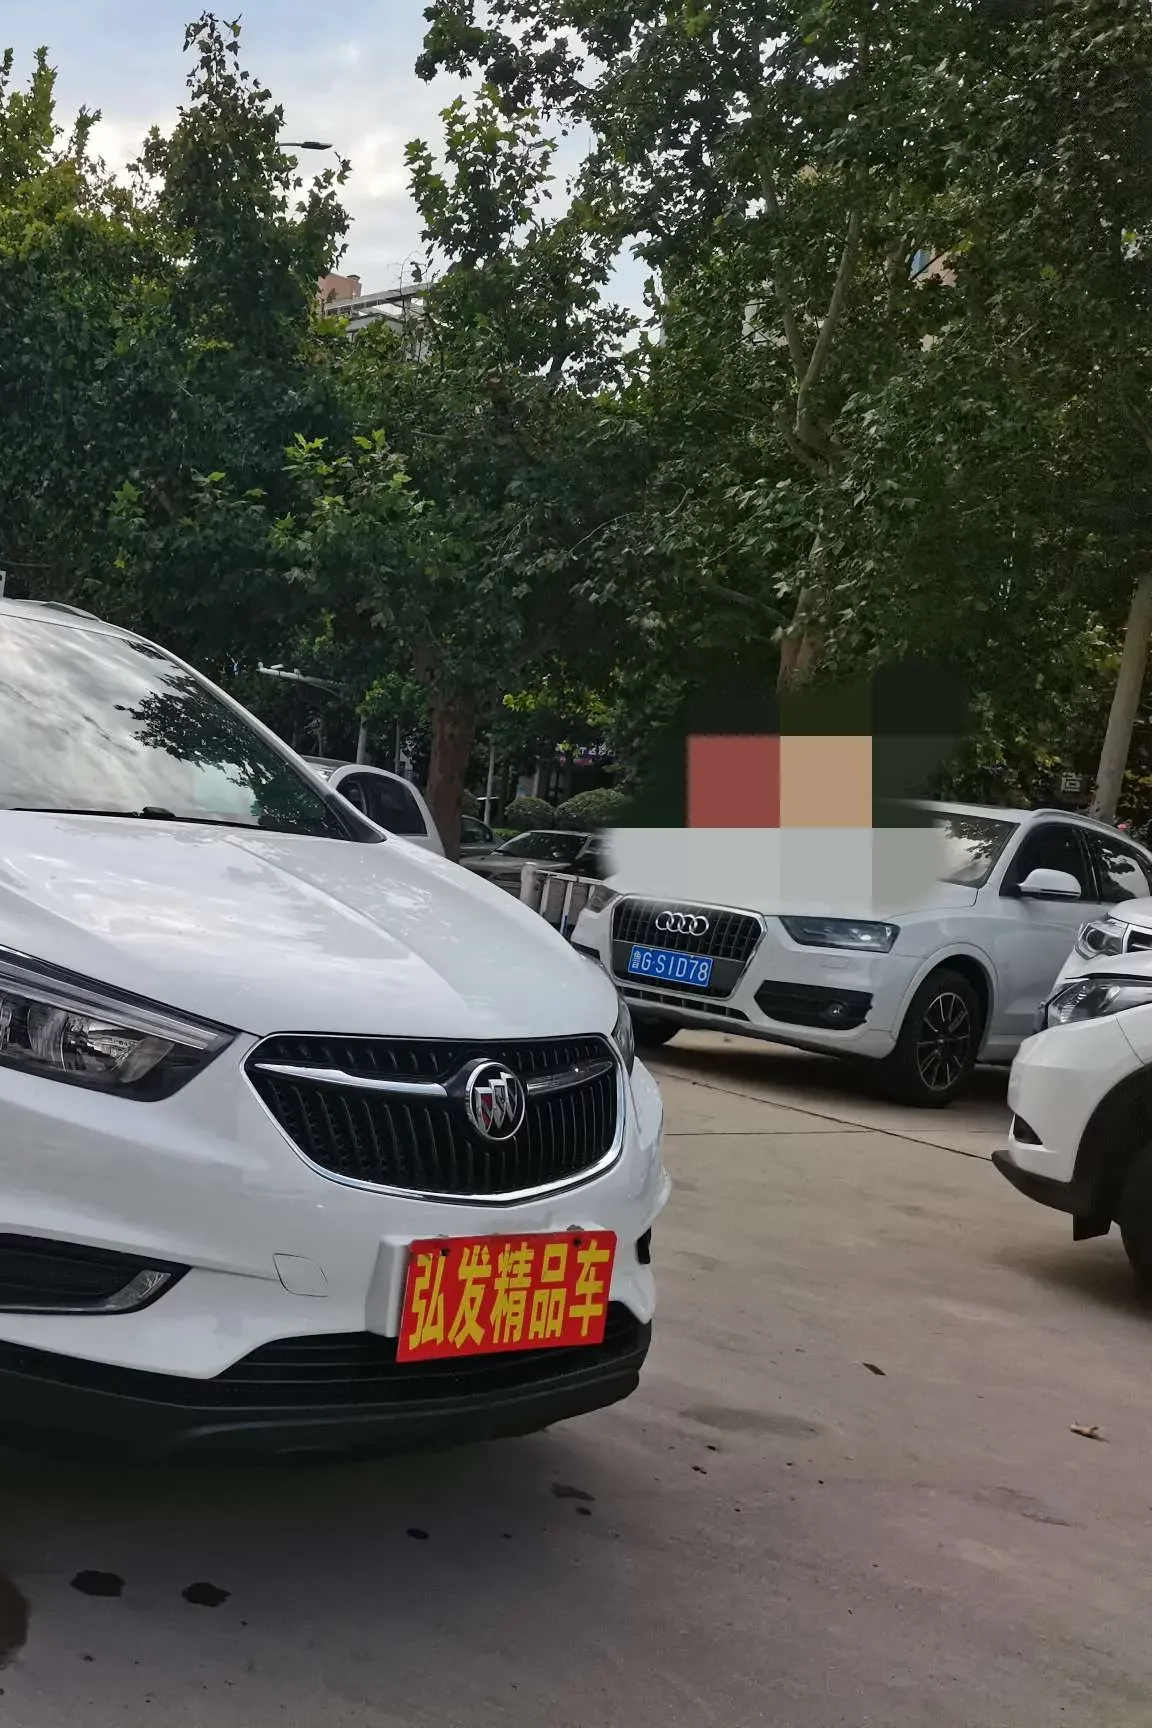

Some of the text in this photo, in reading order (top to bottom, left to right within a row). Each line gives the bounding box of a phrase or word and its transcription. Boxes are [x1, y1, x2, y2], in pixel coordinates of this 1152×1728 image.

[408, 1238, 611, 1351] 弘发精品车
